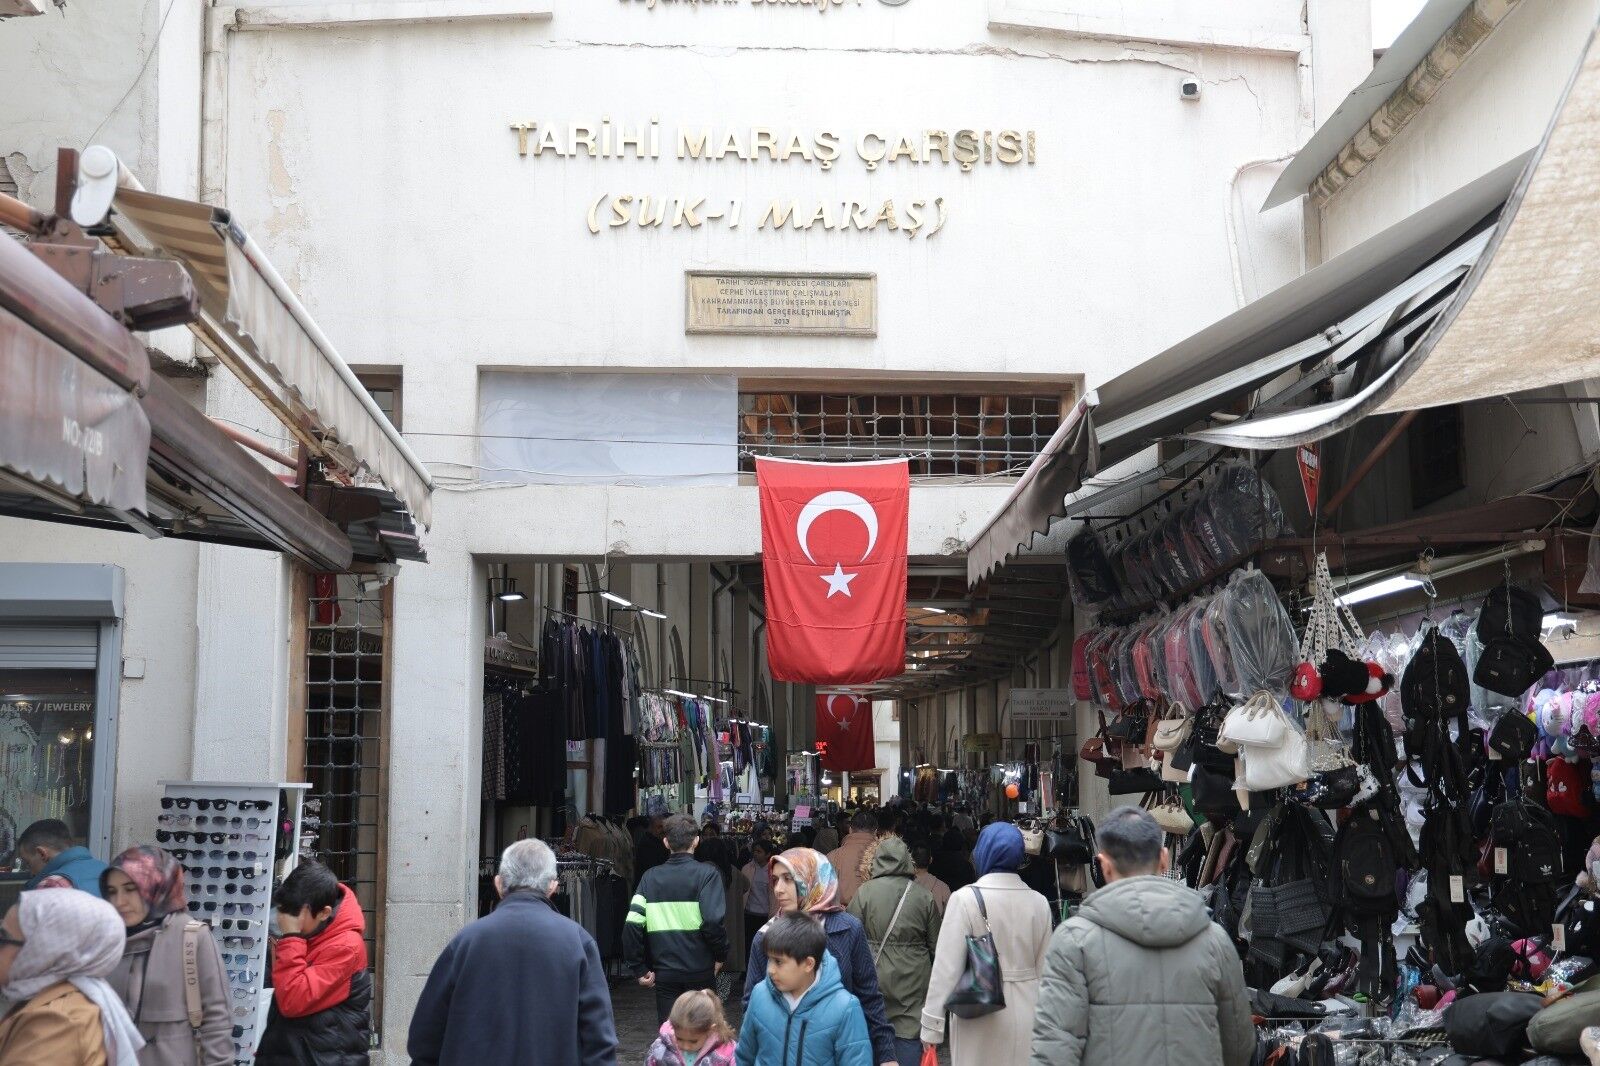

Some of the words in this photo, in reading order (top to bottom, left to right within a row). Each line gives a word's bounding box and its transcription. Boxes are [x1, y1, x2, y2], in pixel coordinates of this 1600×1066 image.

[510, 115, 660, 158] TARİHİ
[676, 125, 842, 170] MARAŞ
[856, 127, 1036, 173] ÇARŞISI
[757, 196, 949, 240] MARAŞ)
[720, 288, 744, 296] CEPHE
[716, 307, 764, 316] TARAFINDAN
[43, 703, 92, 712] JEWELERY
[185, 941, 197, 986] GUESS
